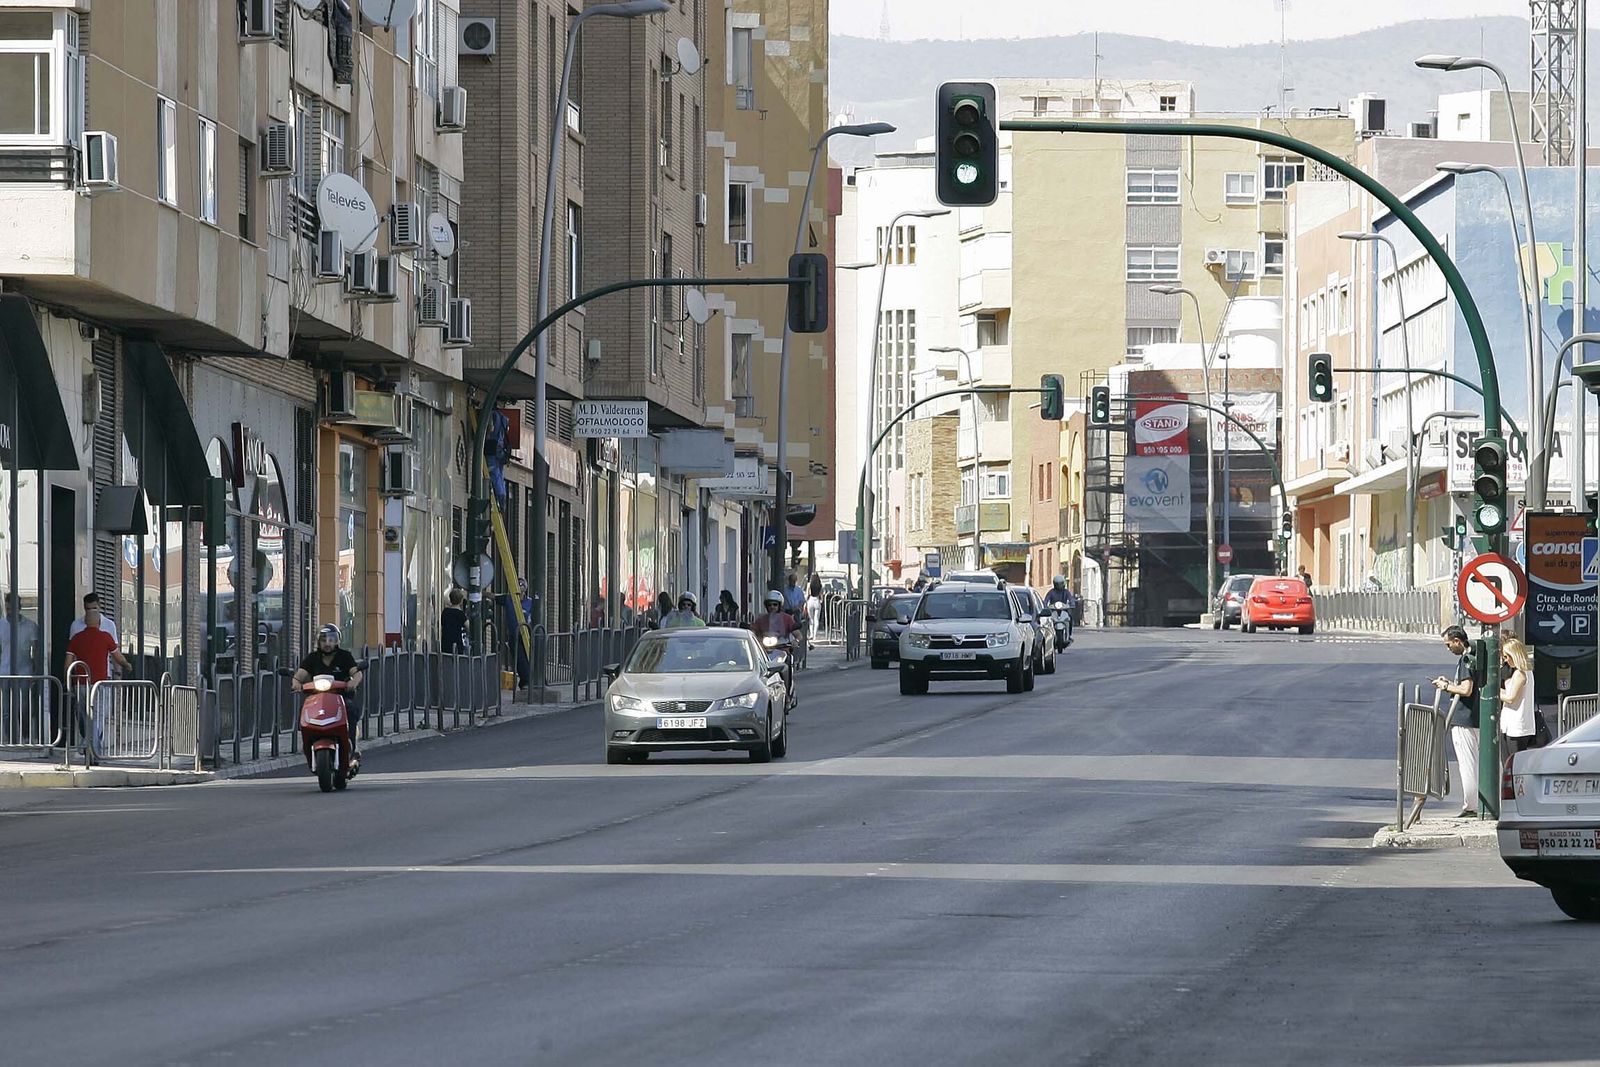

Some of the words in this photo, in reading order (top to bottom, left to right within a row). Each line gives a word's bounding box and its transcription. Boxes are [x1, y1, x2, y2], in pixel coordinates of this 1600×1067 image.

[326, 188, 366, 211] Televés
[590, 404, 599, 415] D.
[600, 404, 644, 416] Valdearenas
[1145, 419, 1180, 428] STAND
[1129, 491, 1184, 507] evovent
[1536, 593, 1559, 603] Ctra.
[1560, 593, 1572, 603] de
[1536, 604, 1546, 613] C/
[1546, 604, 1557, 612] Dr.
[1575, 617, 1588, 633] P
[663, 720, 686, 728] 6198
[688, 719, 705, 728] JFZ
[1552, 780, 1579, 793] 5784
[1540, 839, 1556, 848] 950
[1559, 839, 1569, 848] 22
[1571, 839, 1582, 848] 22
[1584, 839, 1595, 848] 22
